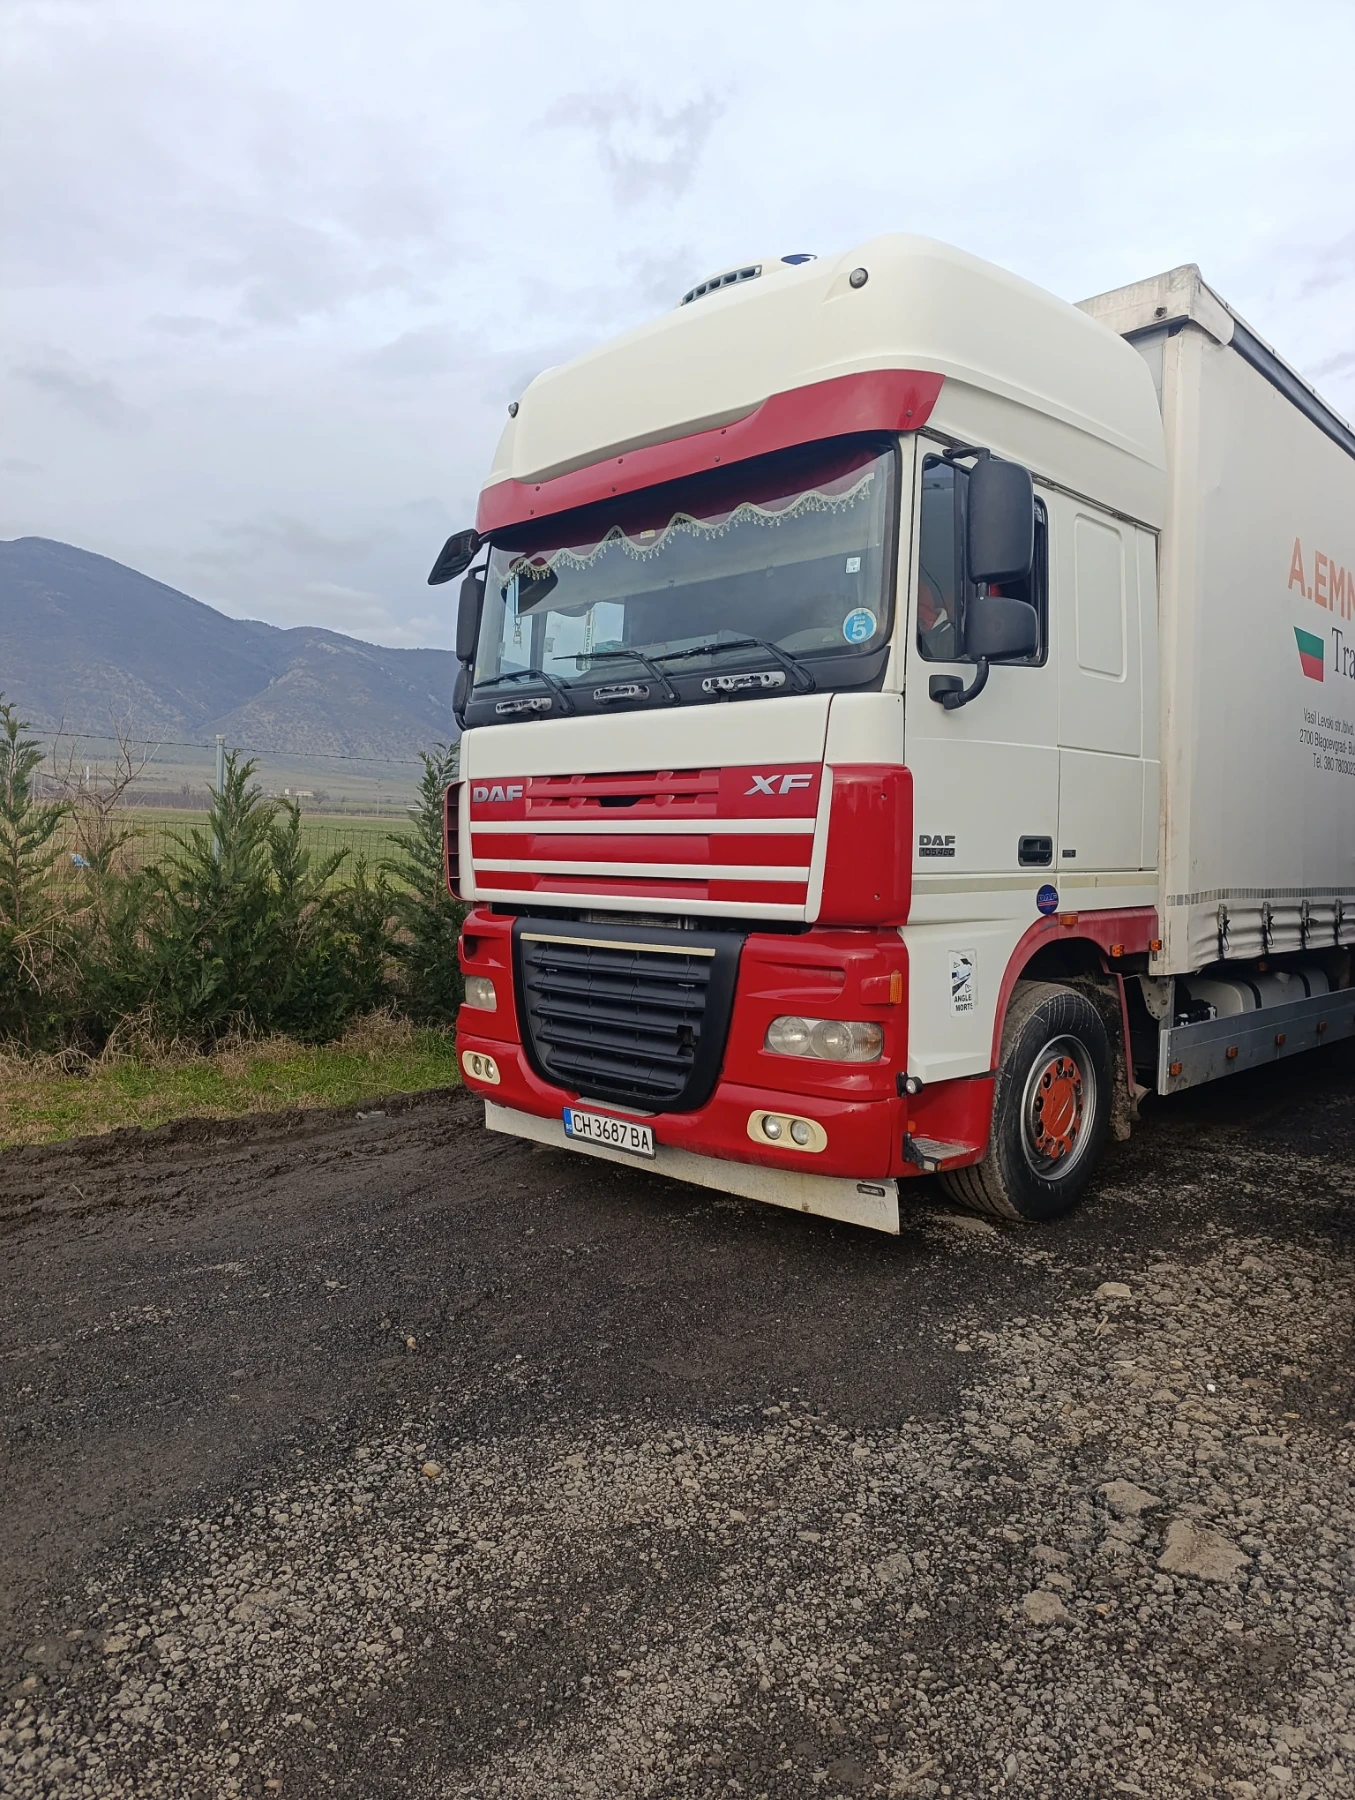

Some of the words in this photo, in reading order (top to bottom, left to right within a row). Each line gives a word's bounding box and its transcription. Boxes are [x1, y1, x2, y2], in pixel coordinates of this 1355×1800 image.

[851, 620, 867, 640] 5
[1303, 707, 1317, 725] Vasil
[472, 784, 524, 803] DAF
[743, 773, 814, 796] XF
[918, 834, 956, 847] DAF
[1037, 892, 1058, 903] DAF
[573, 1113, 592, 1136] CH
[594, 1118, 628, 1144] 3687
[630, 1127, 650, 1151] BA
